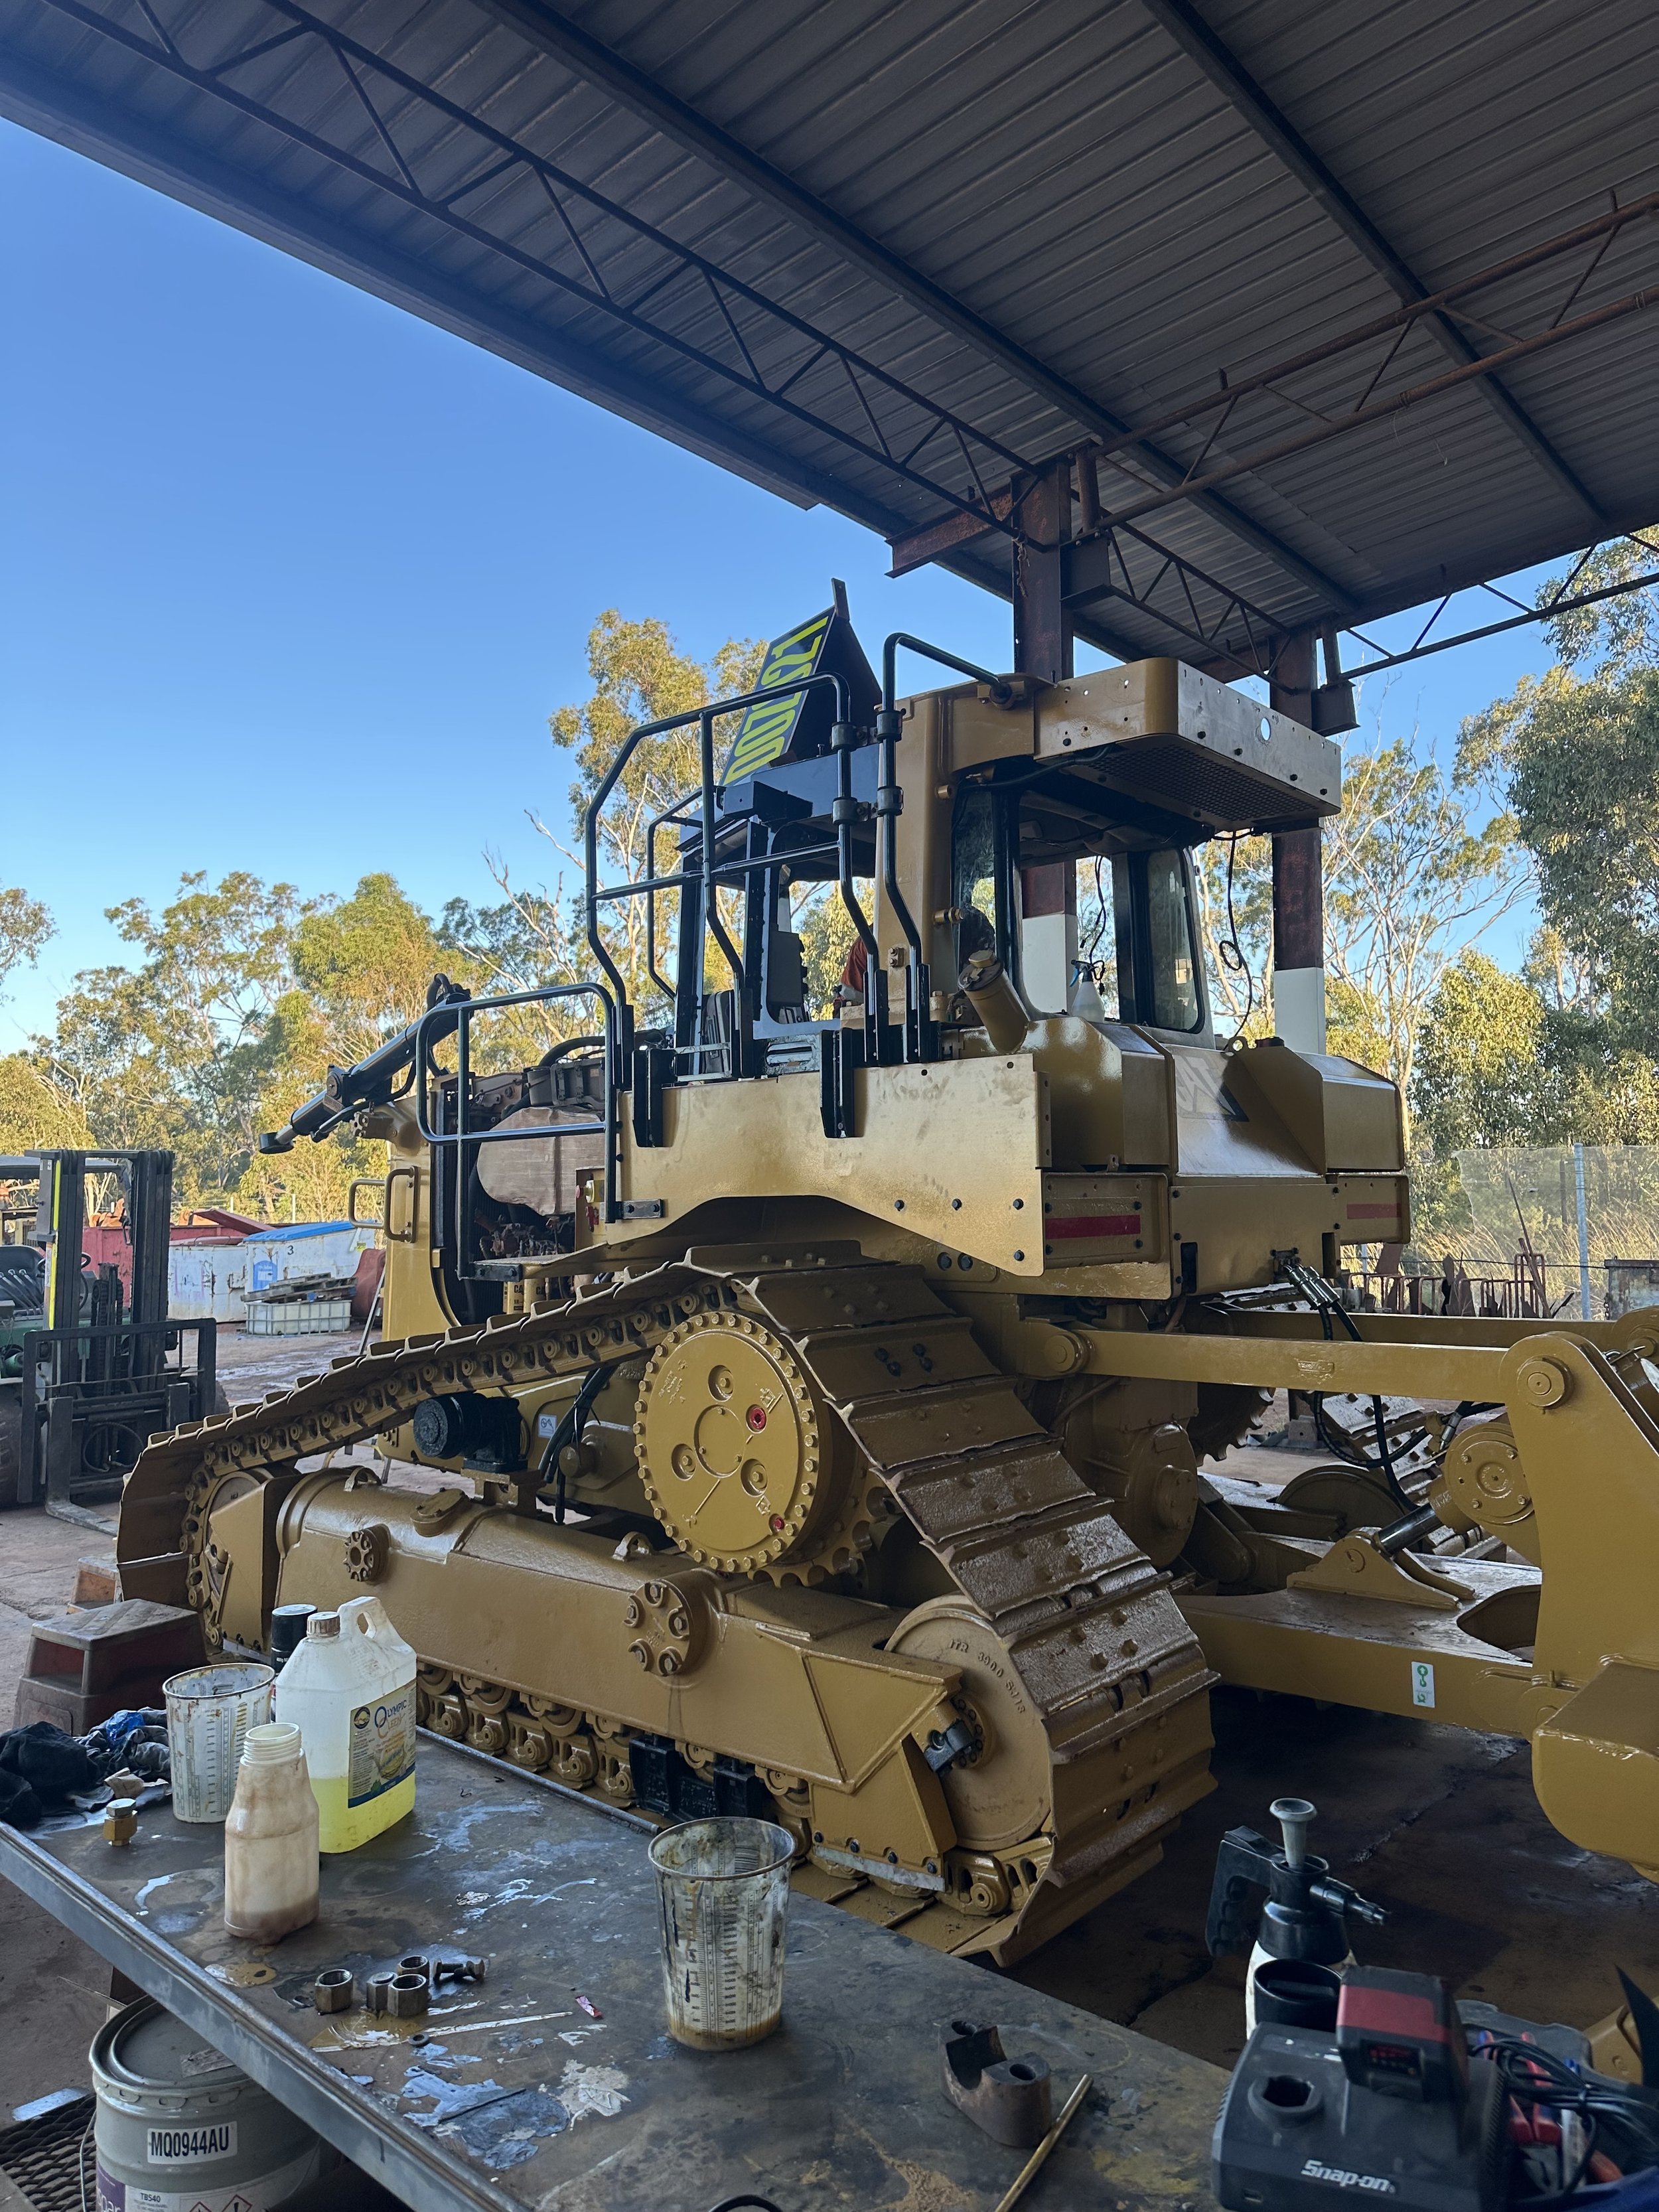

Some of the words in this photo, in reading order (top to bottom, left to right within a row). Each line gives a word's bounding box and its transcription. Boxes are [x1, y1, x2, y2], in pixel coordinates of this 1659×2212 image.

[287, 1245, 294, 1256] 3
[514, 1284, 524, 1294] CA
[949, 1639, 969, 1653] ITR
[977, 1652, 1004, 1678] 3900
[374, 1700, 407, 1728] OLYMPIC
[151, 2126, 229, 2158] MQ0944AU
